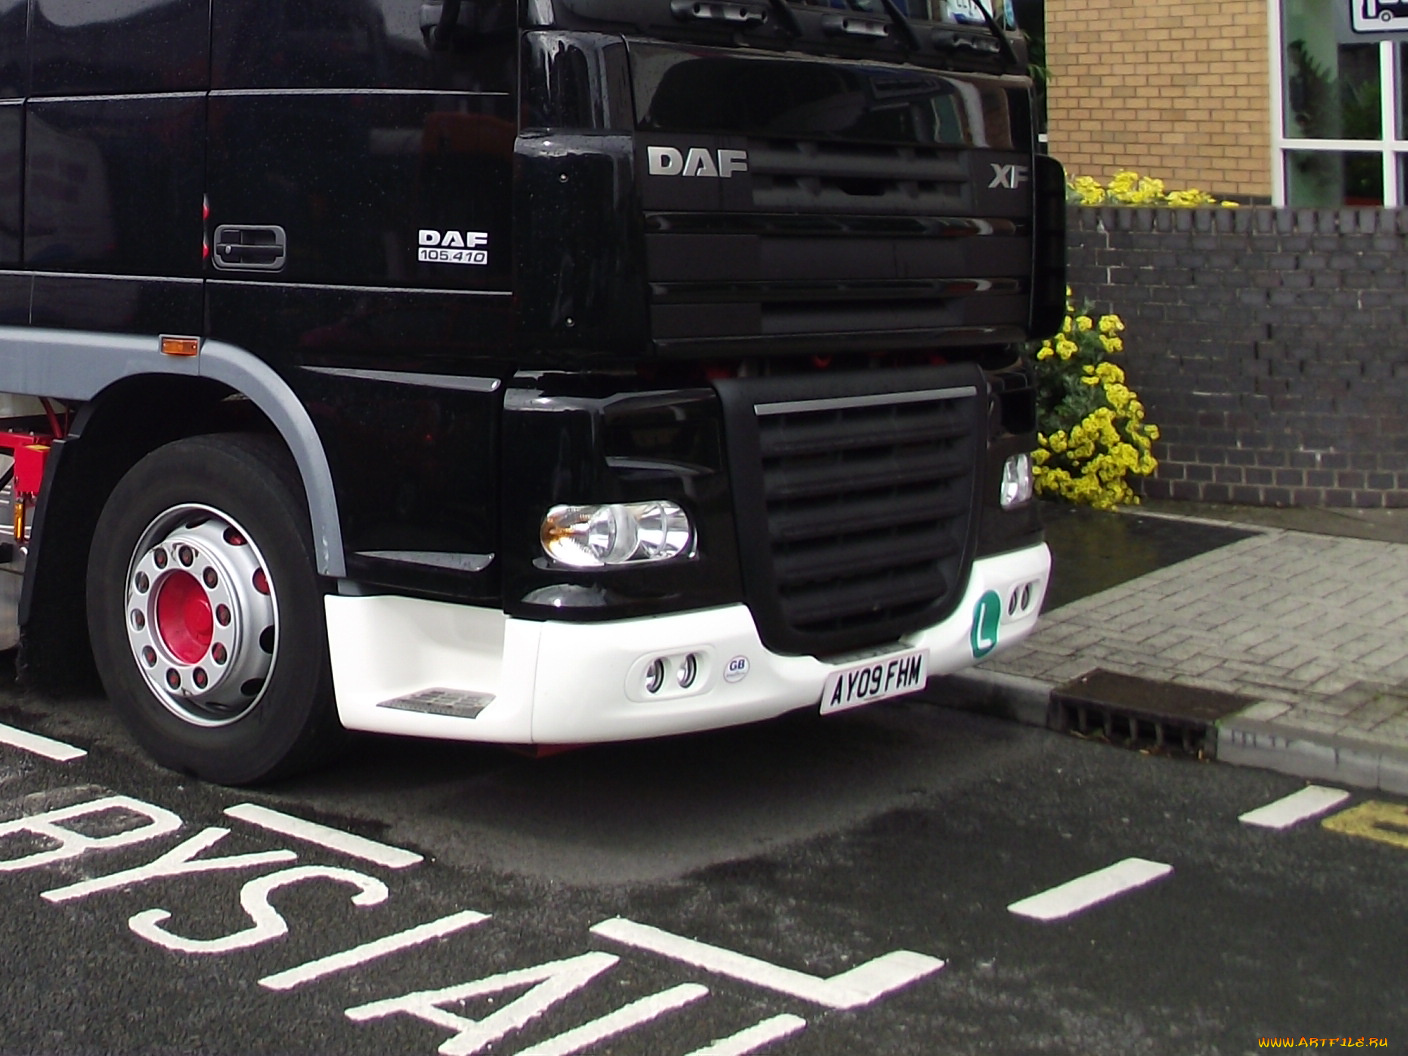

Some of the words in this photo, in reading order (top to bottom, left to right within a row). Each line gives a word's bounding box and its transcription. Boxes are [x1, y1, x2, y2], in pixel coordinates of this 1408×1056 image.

[647, 146, 748, 178] DAF
[988, 163, 1029, 189] XF
[418, 229, 488, 248] DAF
[729, 659, 746, 672] GB
[830, 664, 883, 707] AY09
[884, 654, 922, 693] FHM
